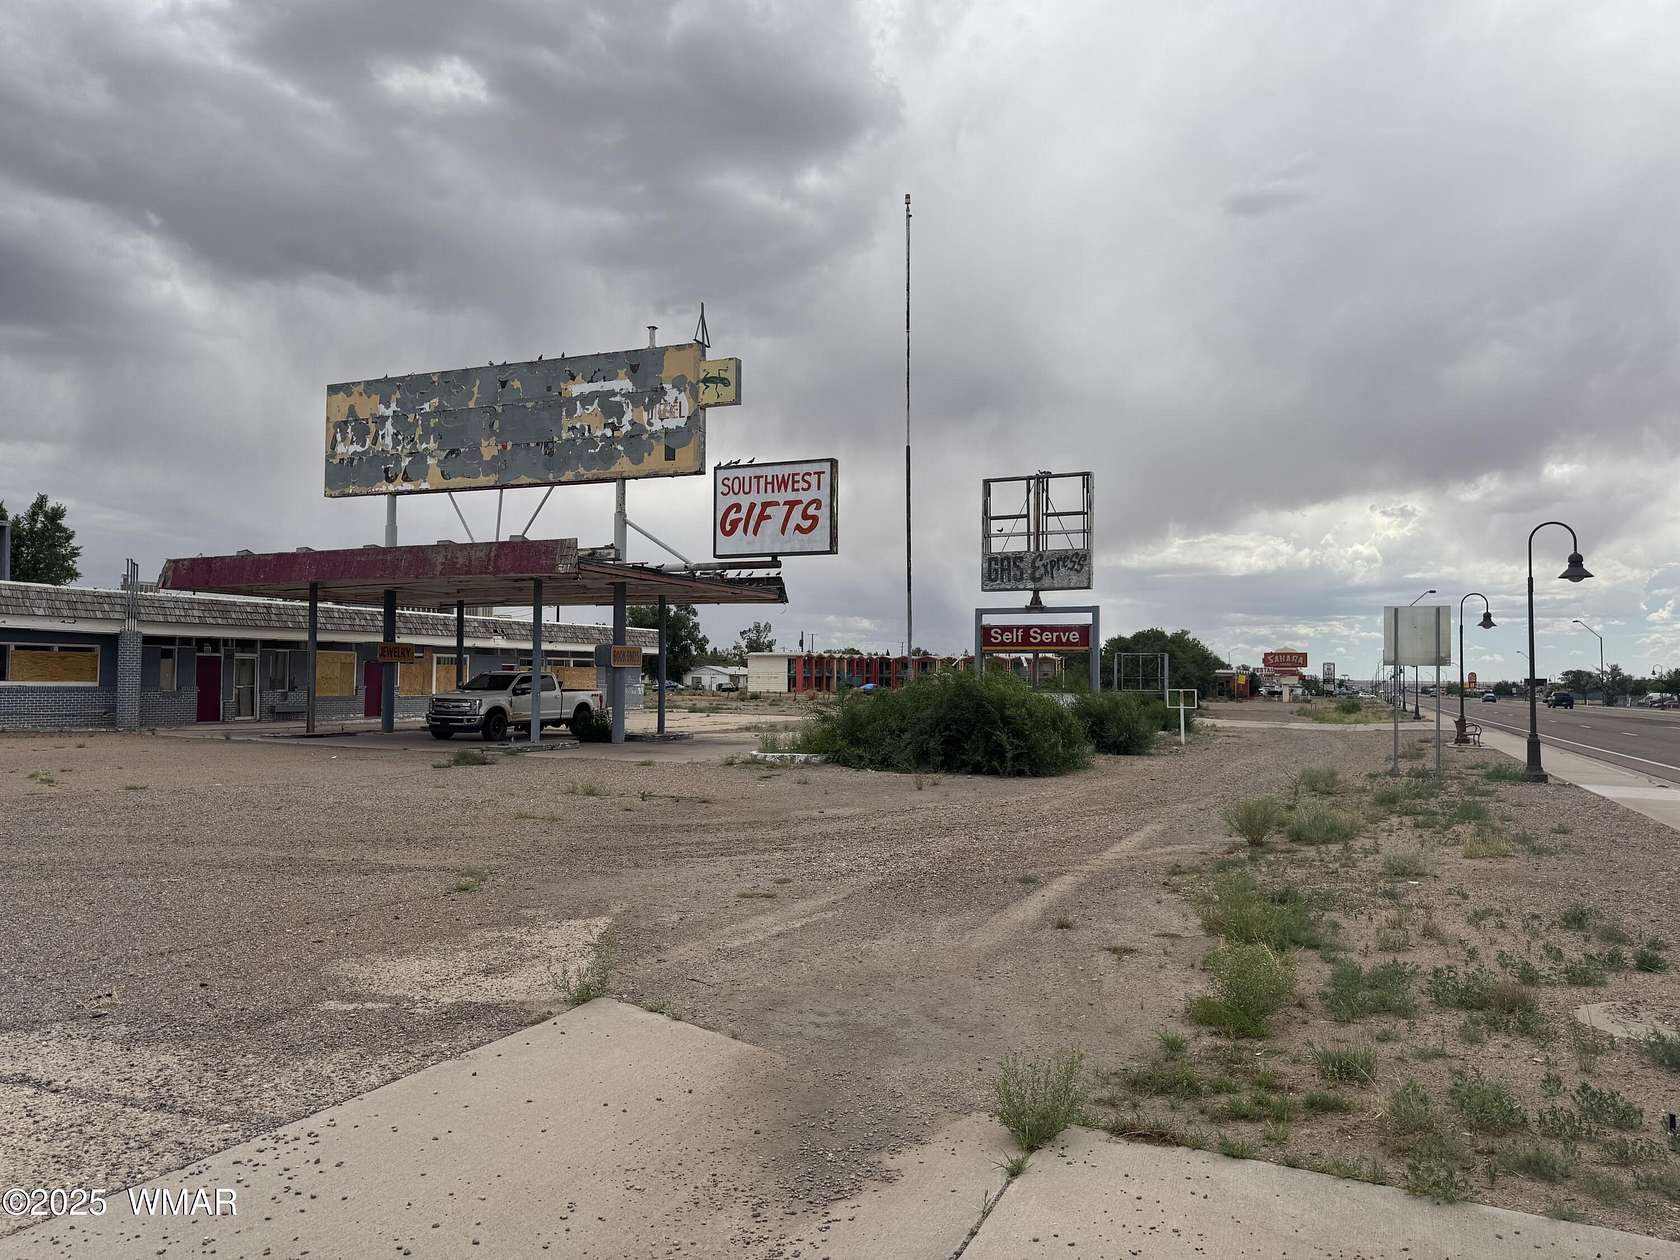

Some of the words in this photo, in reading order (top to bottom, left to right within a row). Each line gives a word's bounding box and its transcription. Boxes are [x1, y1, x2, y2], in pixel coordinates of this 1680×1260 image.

[720, 470, 825, 496] SOUTHWEST
[720, 498, 822, 537] GIFTS
[990, 628, 1024, 643] Self
[1029, 628, 1080, 643] Serve
[1266, 655, 1304, 665] SAHARA
